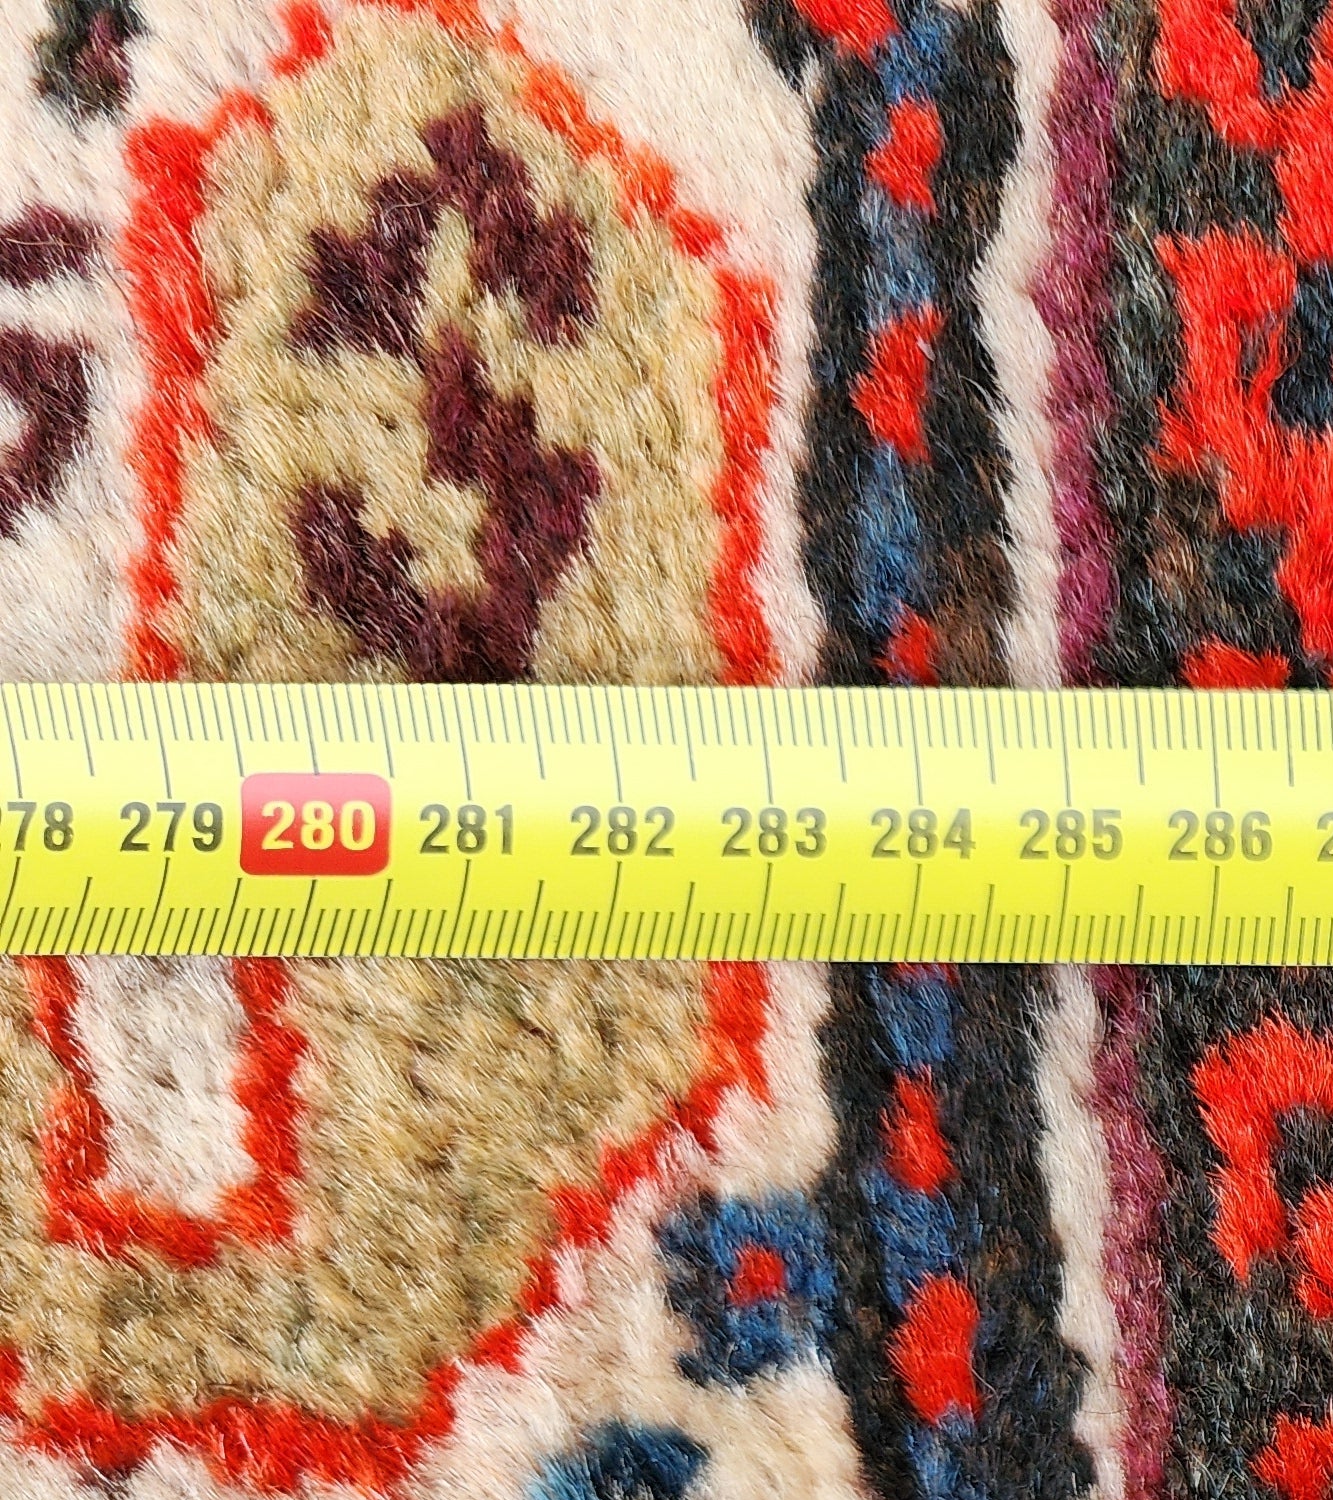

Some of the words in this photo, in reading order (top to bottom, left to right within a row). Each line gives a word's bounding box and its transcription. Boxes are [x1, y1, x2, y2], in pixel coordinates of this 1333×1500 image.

[0, 802, 73, 851] 78
[120, 802, 222, 852] 279
[262, 800, 375, 851] 280
[420, 804, 511, 854] 281
[571, 806, 673, 856] 282
[722, 808, 825, 857] 283
[872, 809, 973, 857] 284
[1021, 810, 1120, 858] 285
[1169, 811, 1271, 859] 286
